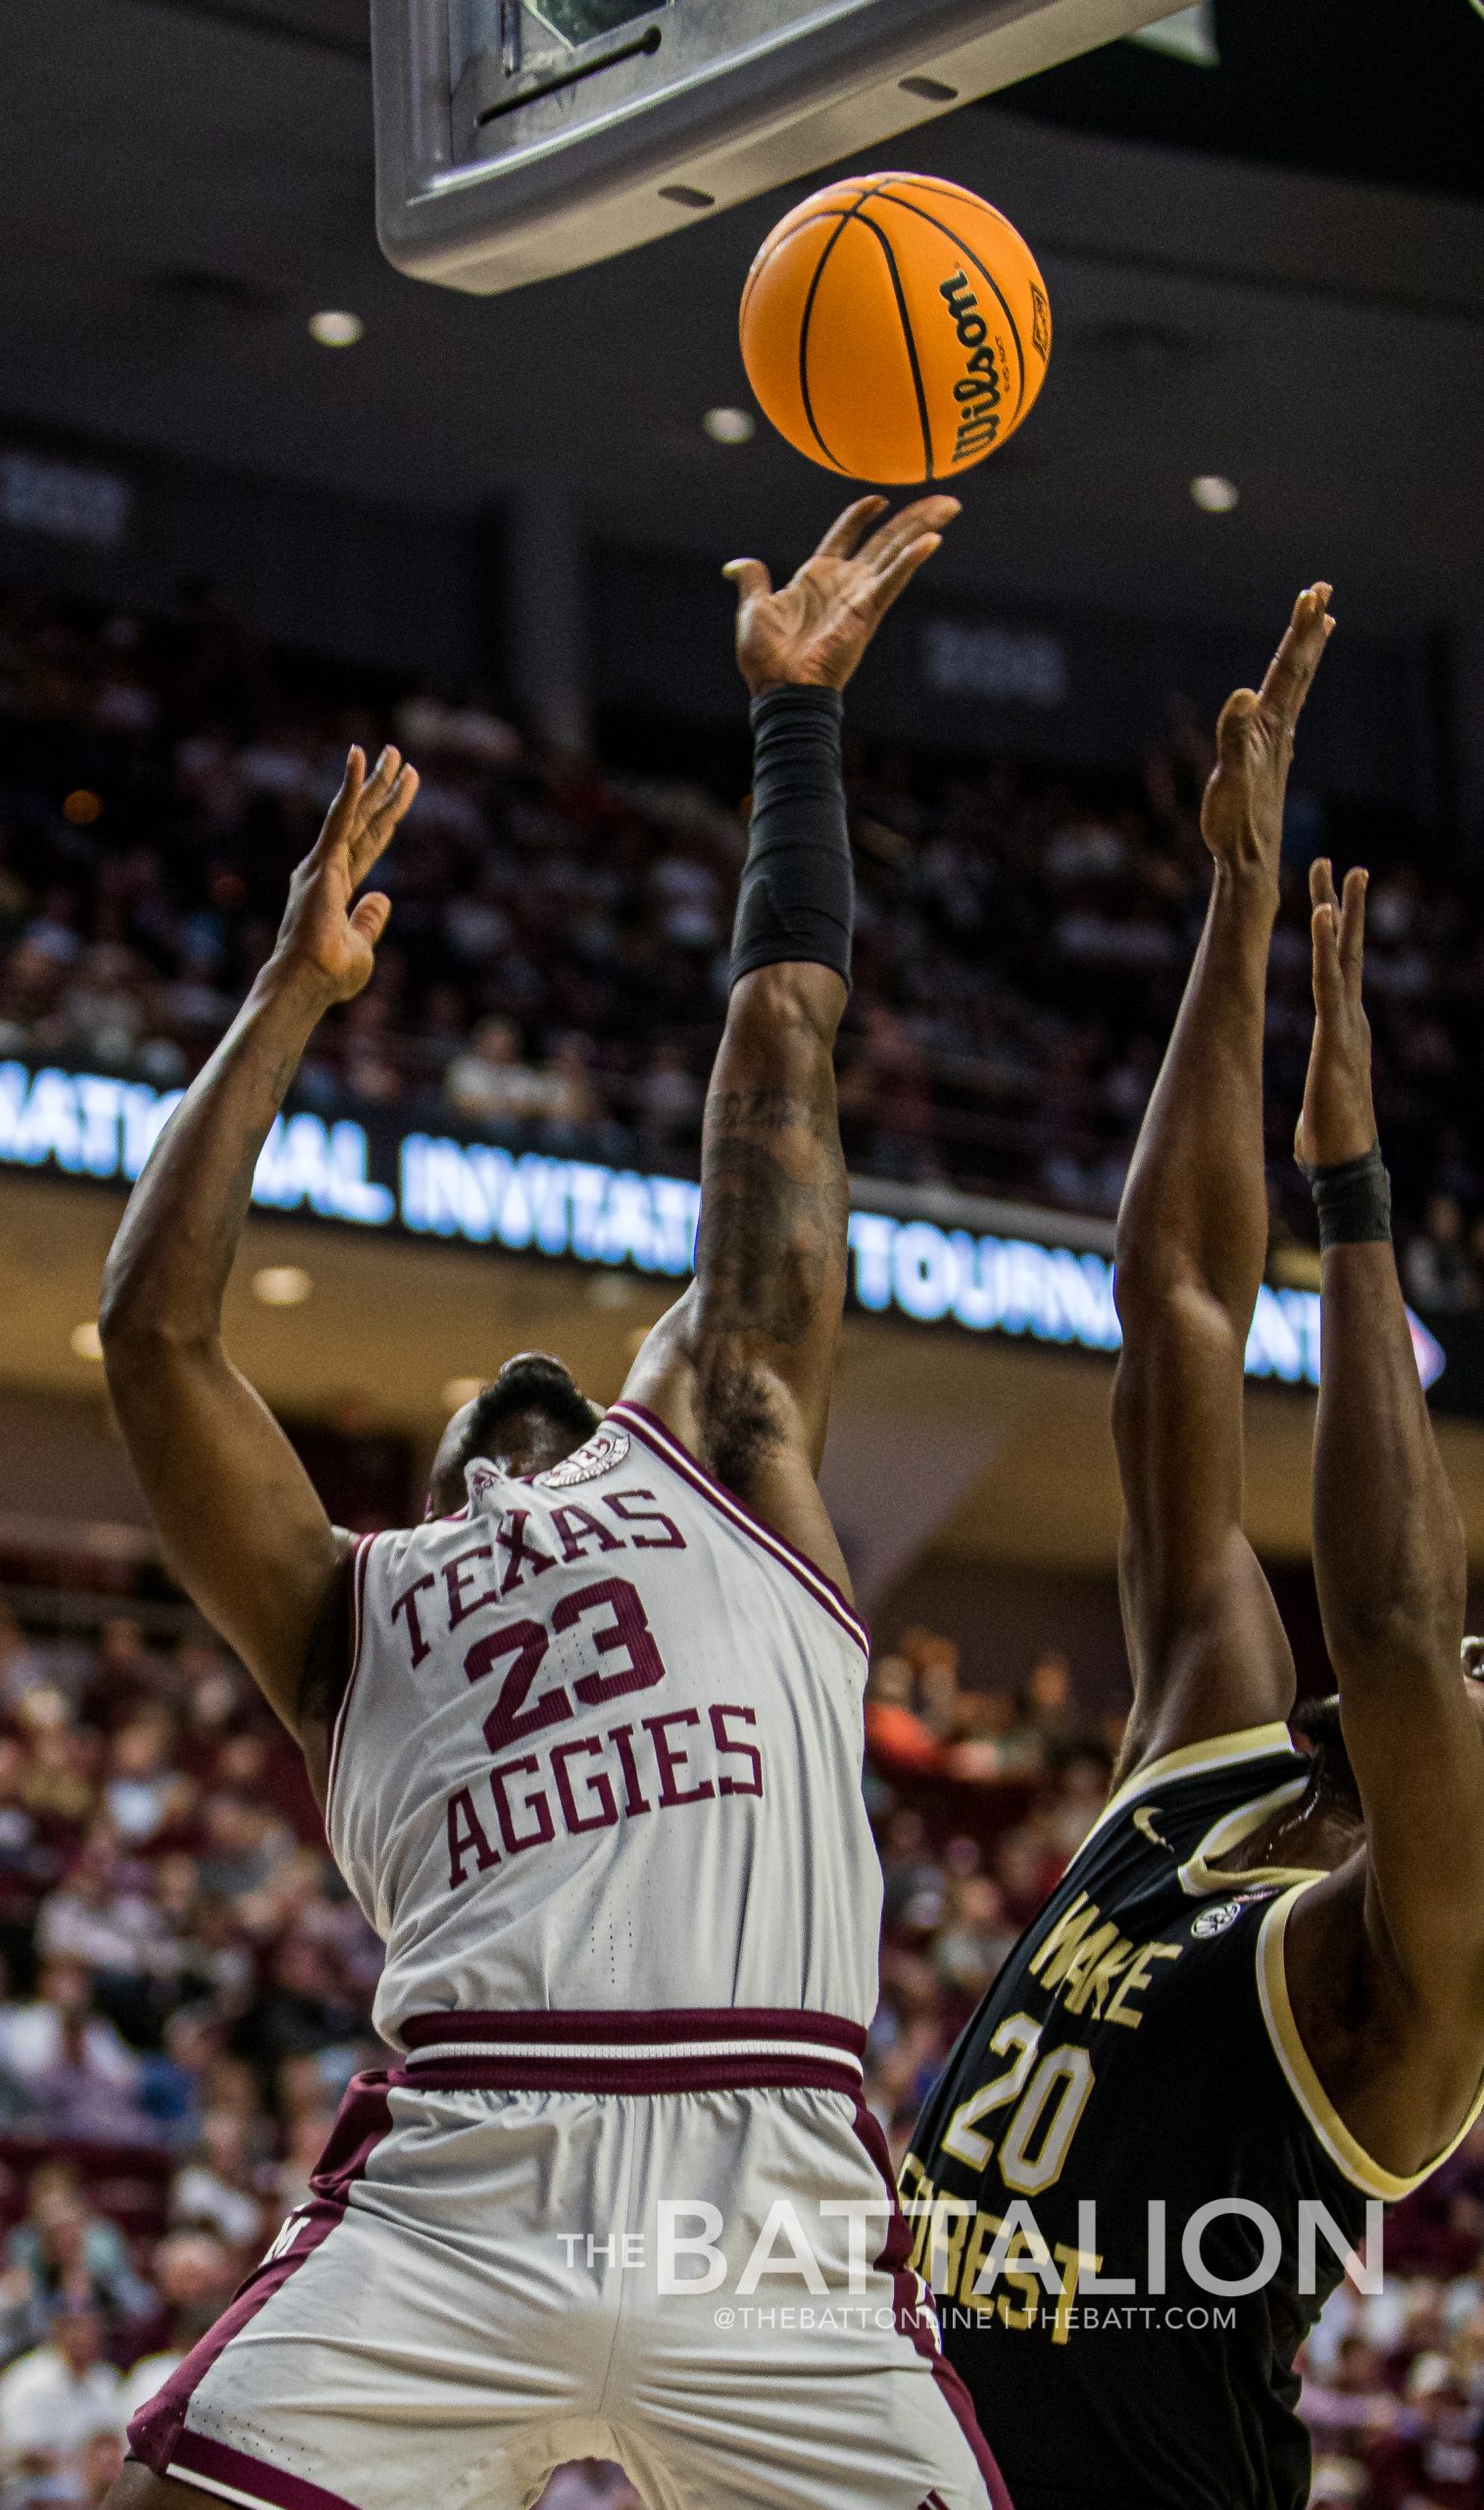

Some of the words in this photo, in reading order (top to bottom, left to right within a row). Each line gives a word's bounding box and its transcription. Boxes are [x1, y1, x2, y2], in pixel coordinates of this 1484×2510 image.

[939, 268, 1001, 463] Wilson
[391, 1488, 687, 1669] TEXAS
[463, 1576, 667, 1754] 23
[448, 1703, 764, 1891] AGGIES
[1028, 1889, 1183, 2030] WAKE
[941, 2011, 1096, 2197] 20
